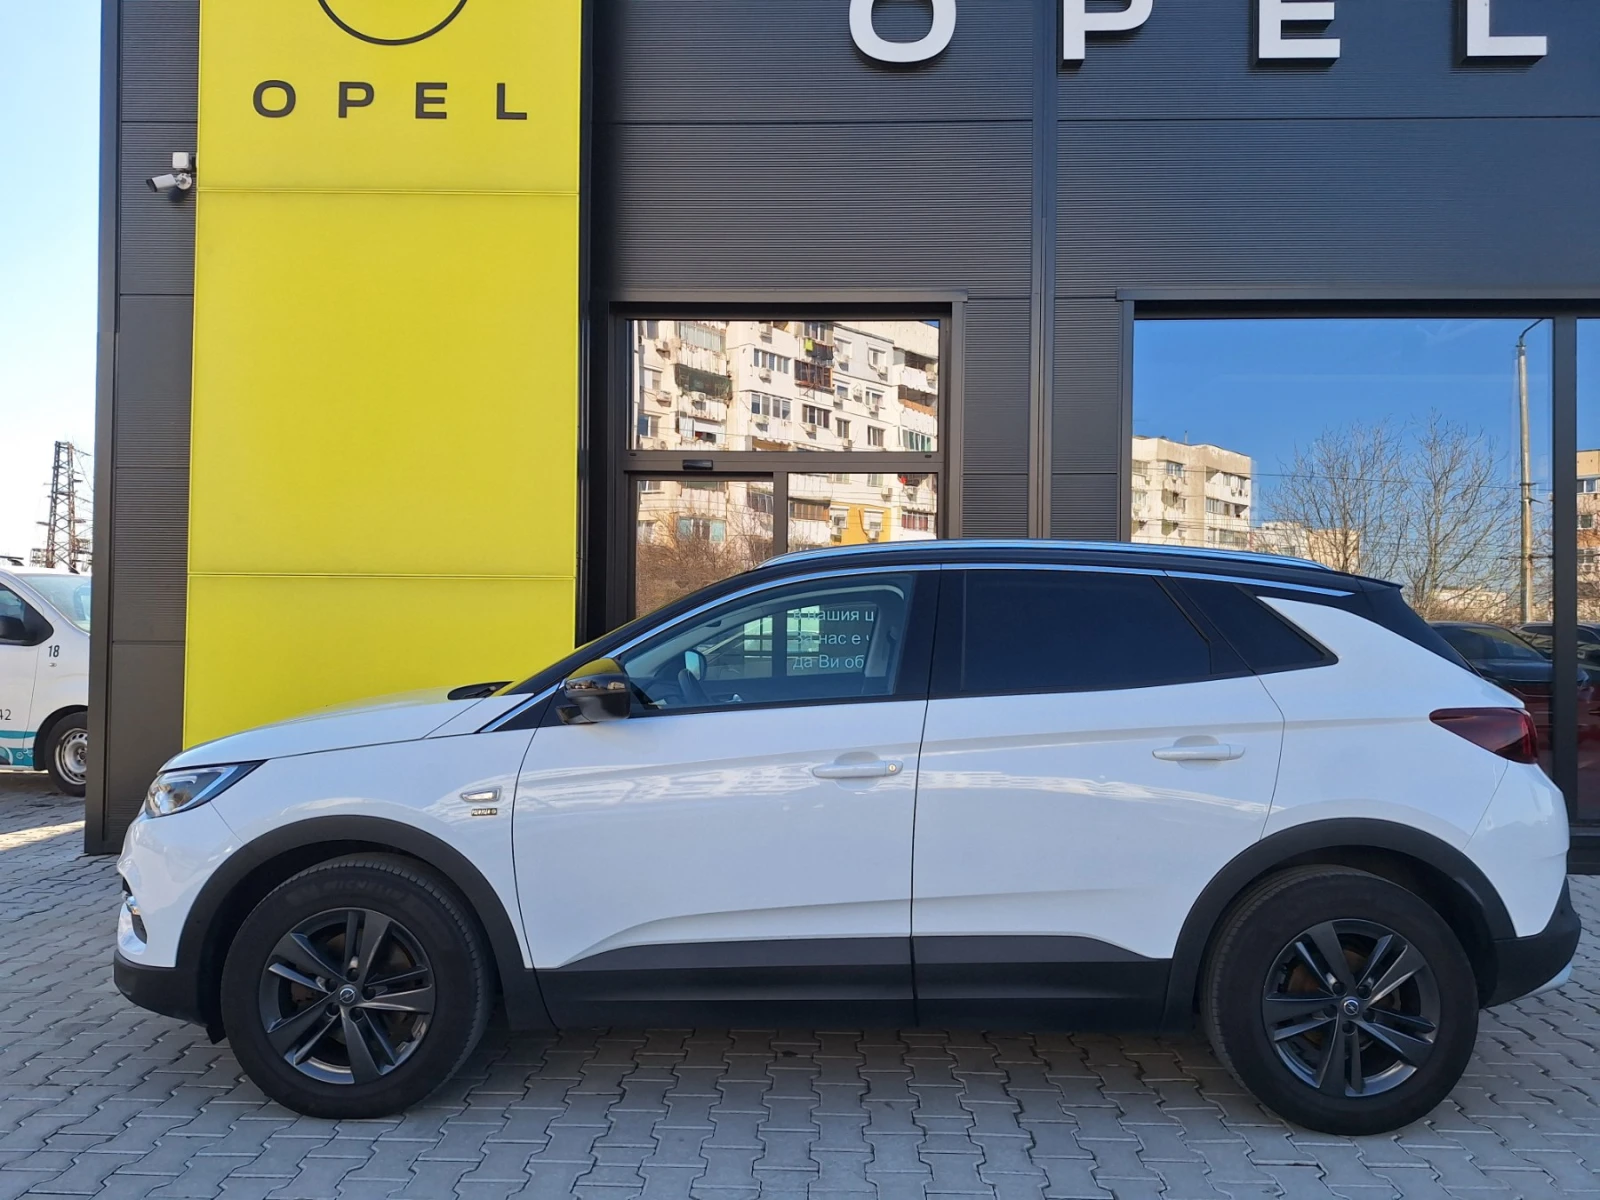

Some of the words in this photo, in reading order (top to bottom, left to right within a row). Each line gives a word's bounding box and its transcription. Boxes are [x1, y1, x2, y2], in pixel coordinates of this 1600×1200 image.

[849, 0, 1547, 63] OPEL
[253, 80, 527, 120] OPEL
[807, 609, 859, 621] нашия
[819, 633, 847, 645] нас
[851, 633, 861, 645] е
[48, 645, 60, 658] 18
[793, 656, 813, 670] да
[819, 654, 840, 668] Ви
